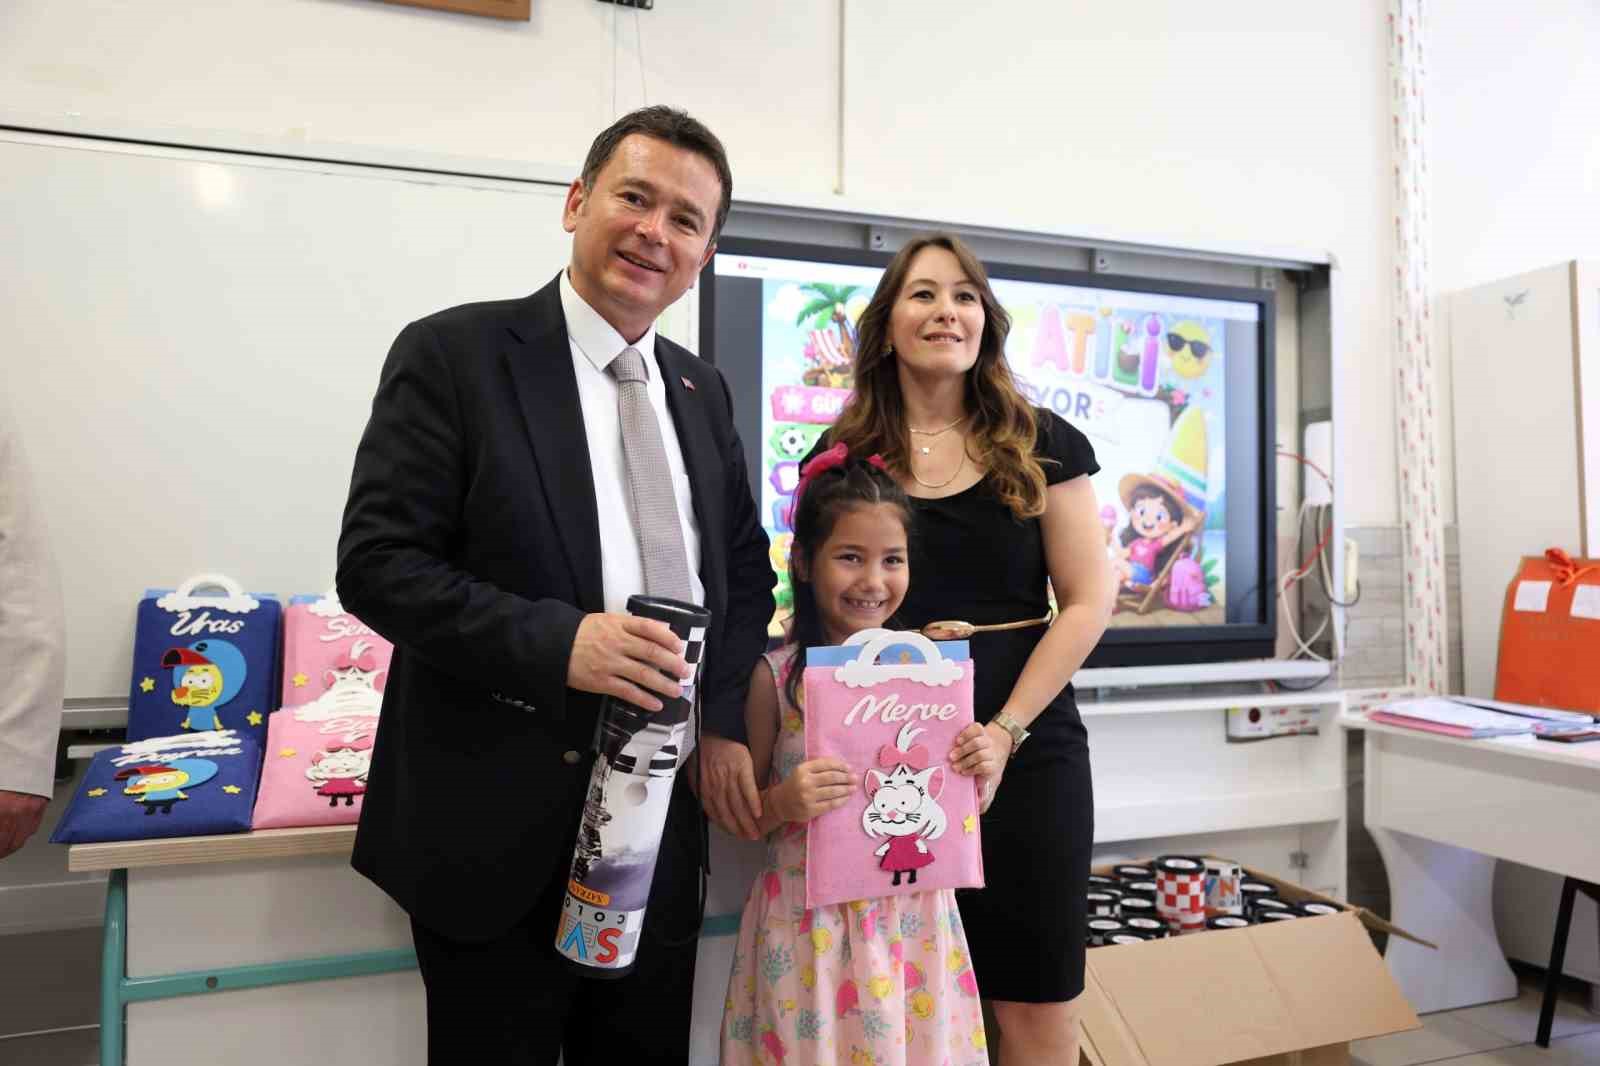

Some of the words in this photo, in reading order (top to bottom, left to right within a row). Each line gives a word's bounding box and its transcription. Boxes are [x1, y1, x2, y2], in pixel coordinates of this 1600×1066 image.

[1018, 383, 1091, 419] YOR
[170, 611, 245, 636] Uras
[843, 693, 959, 726] Merve
